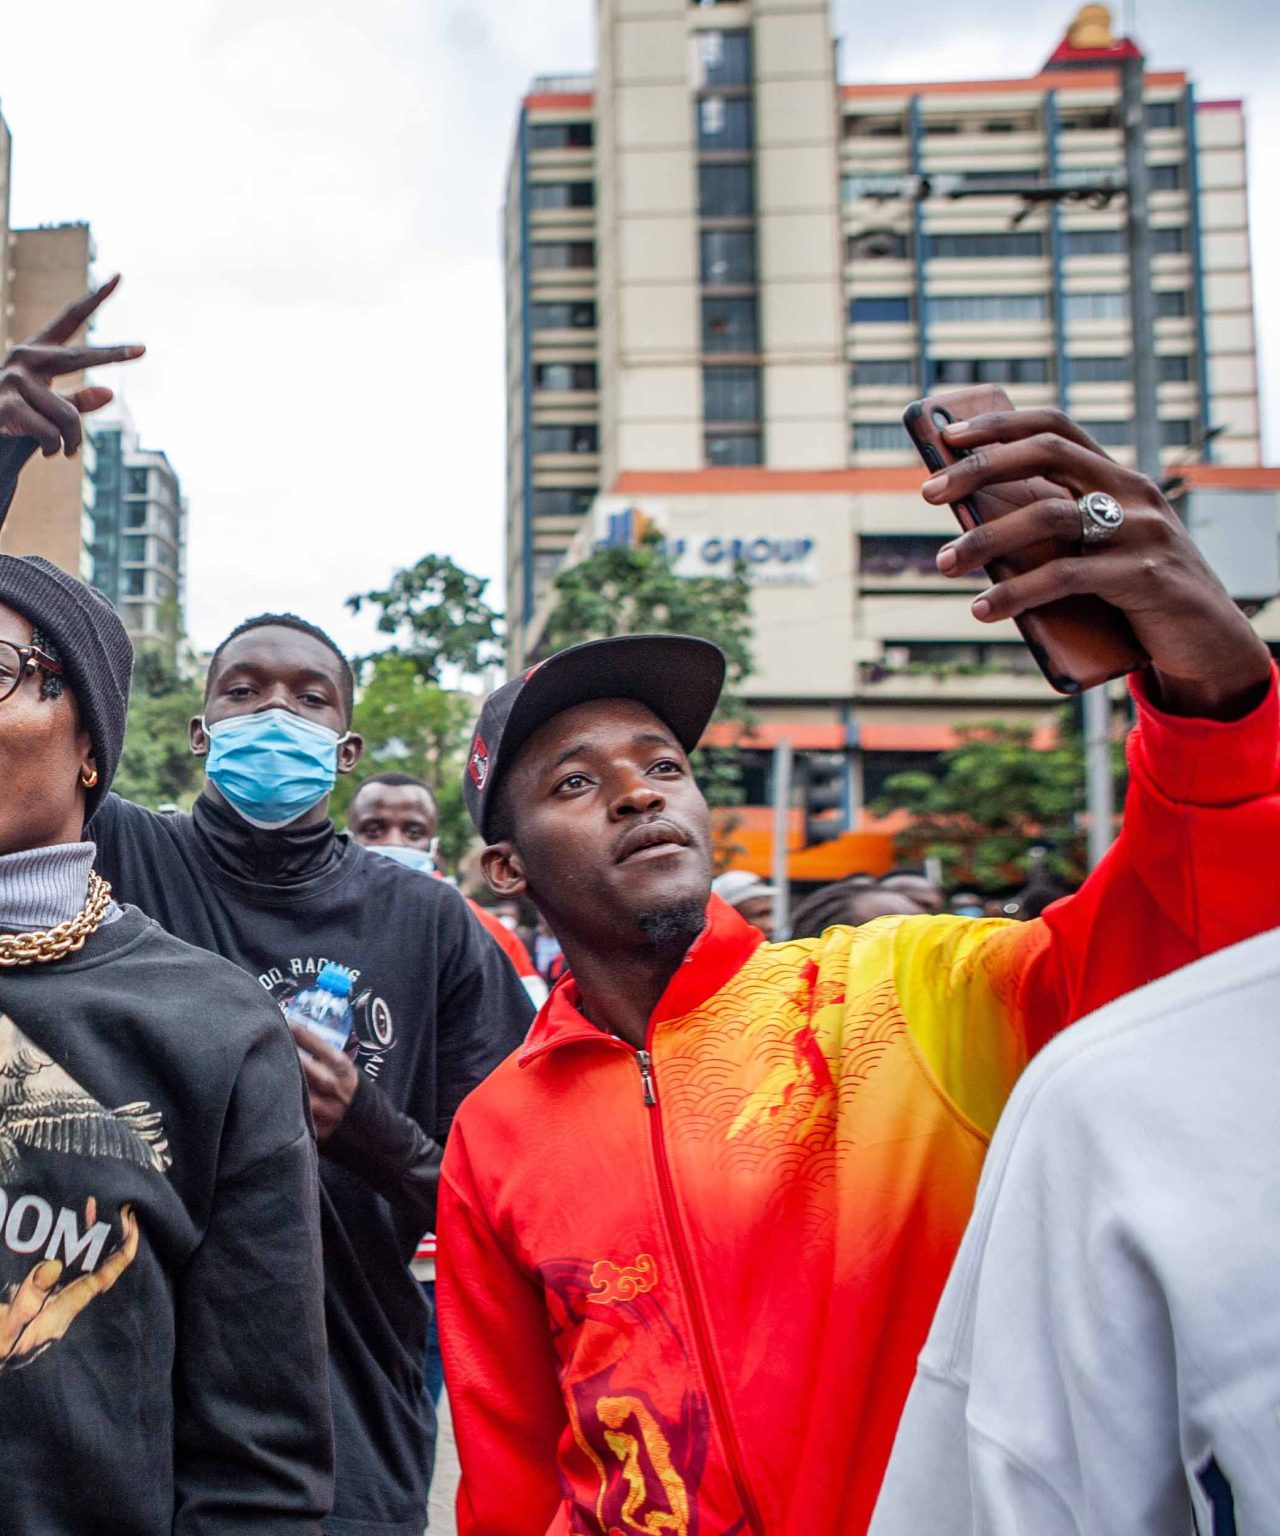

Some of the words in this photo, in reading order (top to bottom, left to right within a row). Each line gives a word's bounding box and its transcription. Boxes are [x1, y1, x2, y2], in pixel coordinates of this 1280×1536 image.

[701, 538, 815, 565] GROUP
[259, 967, 283, 991] OD
[289, 957, 361, 983] RACG
